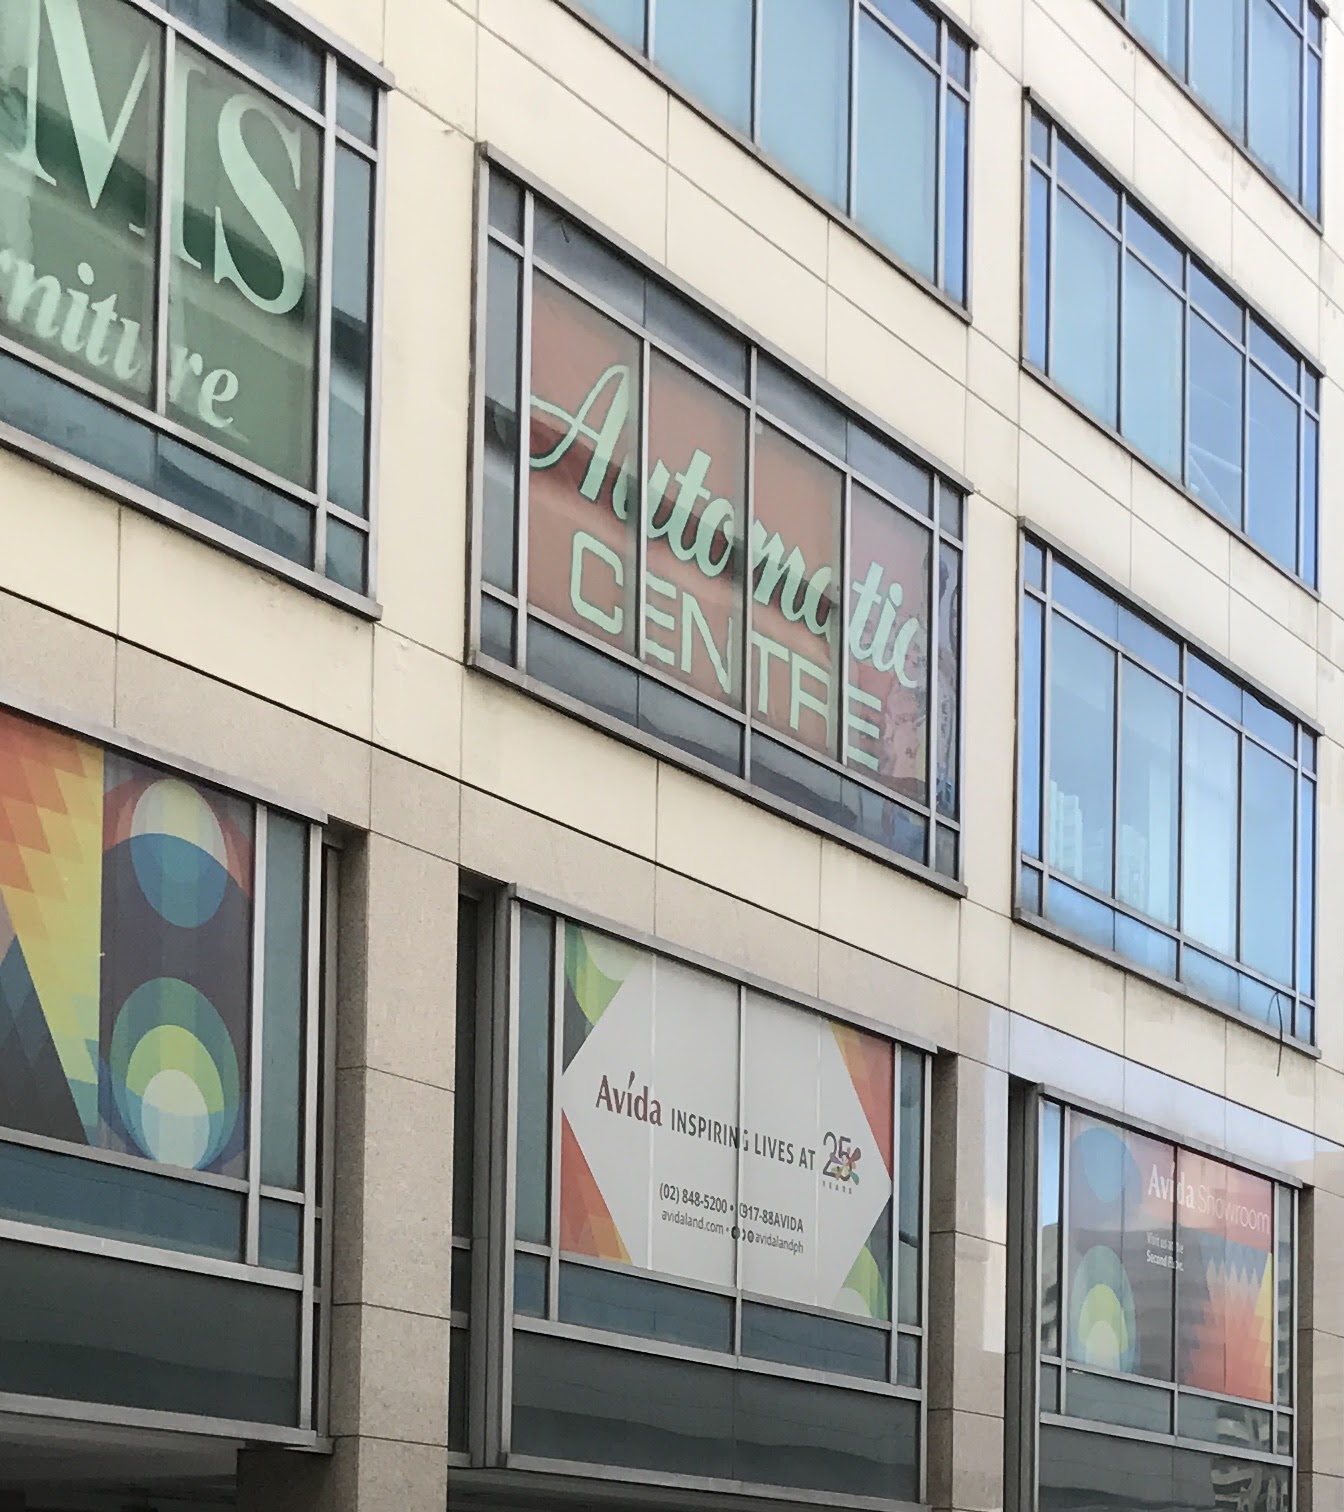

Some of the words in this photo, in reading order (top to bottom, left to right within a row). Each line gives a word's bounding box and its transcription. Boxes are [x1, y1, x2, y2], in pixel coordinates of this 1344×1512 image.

[529, 364, 918, 690] Automatic
[570, 529, 882, 773] CENTRE
[671, 1108, 749, 1152] INSPIRING
[754, 1132, 794, 1165] LIVES
[798, 1147, 816, 1171] AT
[822, 1131, 852, 1182] 25
[659, 1182, 680, 1204] (02)
[682, 1188, 728, 1214] 848-5200
[661, 1209, 724, 1235] avidaland.com
[1197, 1184, 1270, 1235] Showroom
